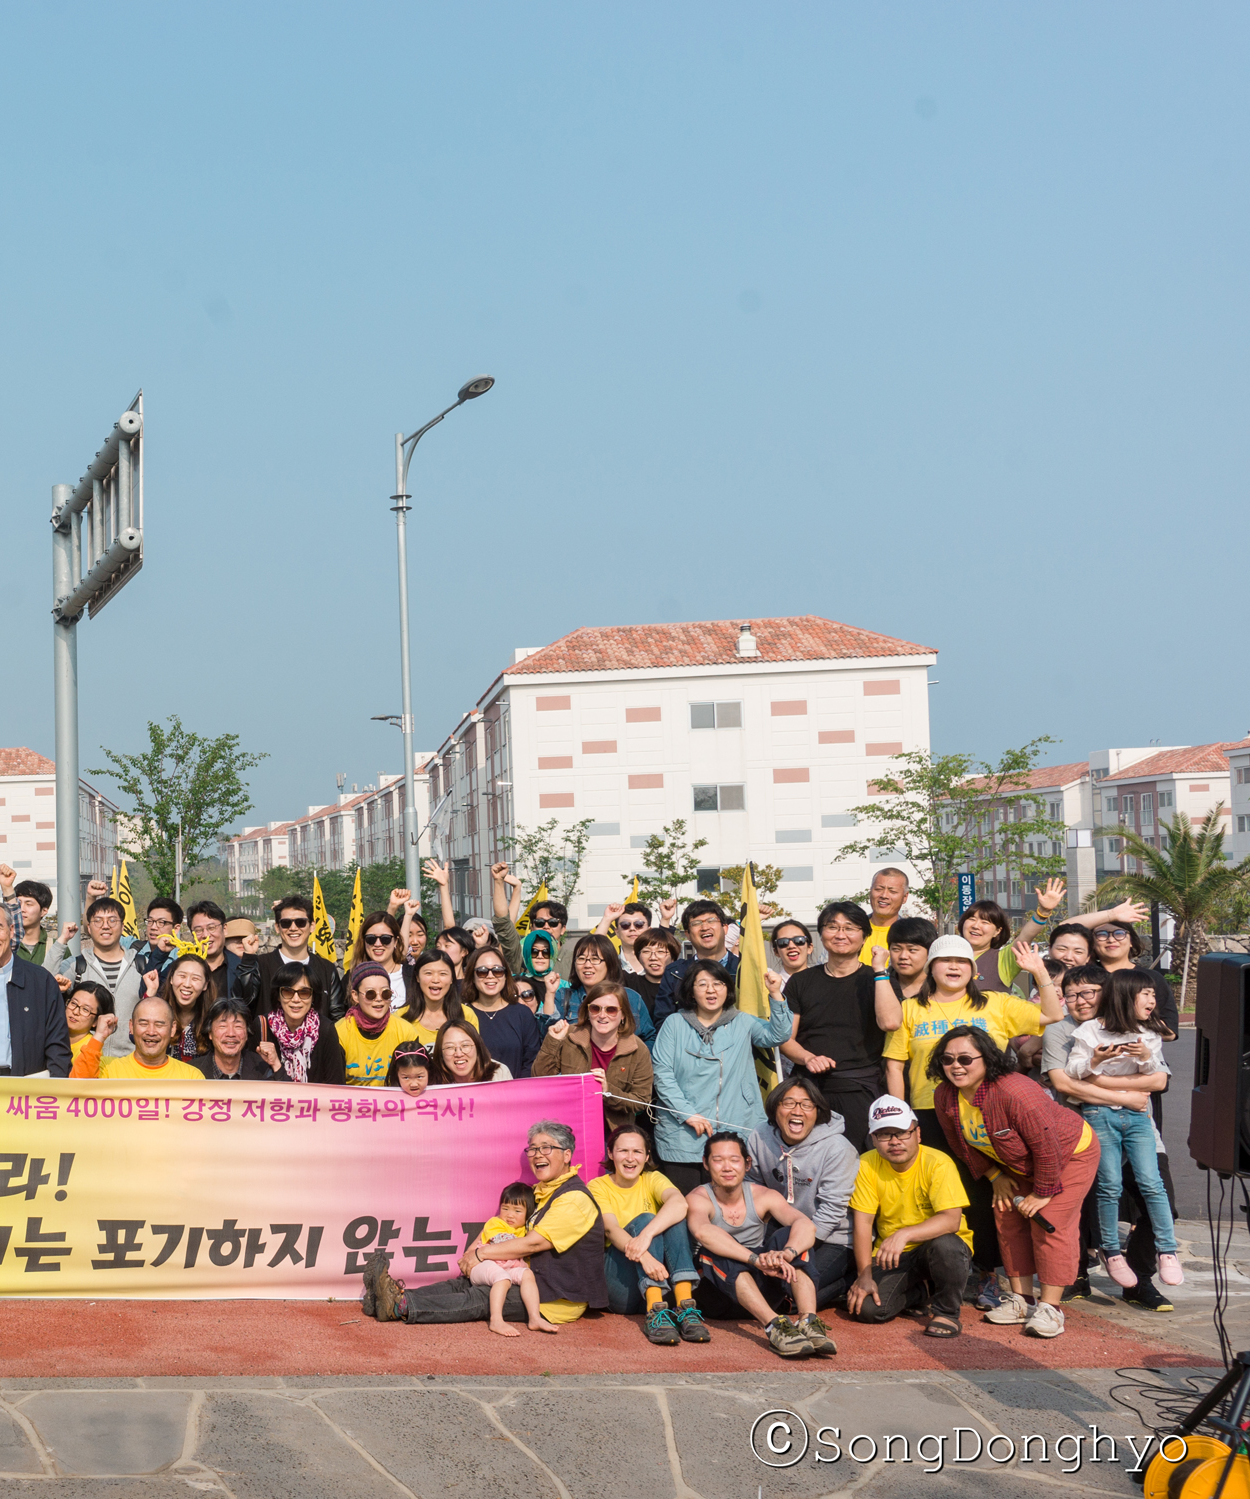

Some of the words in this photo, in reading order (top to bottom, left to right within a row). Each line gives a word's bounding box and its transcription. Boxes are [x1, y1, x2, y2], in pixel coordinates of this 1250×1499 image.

[6, 1095, 60, 1120] 싸움
[66, 1097, 170, 1121] 4000일!
[181, 1098, 233, 1122] 강정
[241, 1097, 320, 1122] 저항과
[329, 1098, 405, 1122] 평화의
[415, 1097, 475, 1122] 역사!
[91, 1218, 325, 1270] 포기하지
[343, 1215, 483, 1275] 않는
